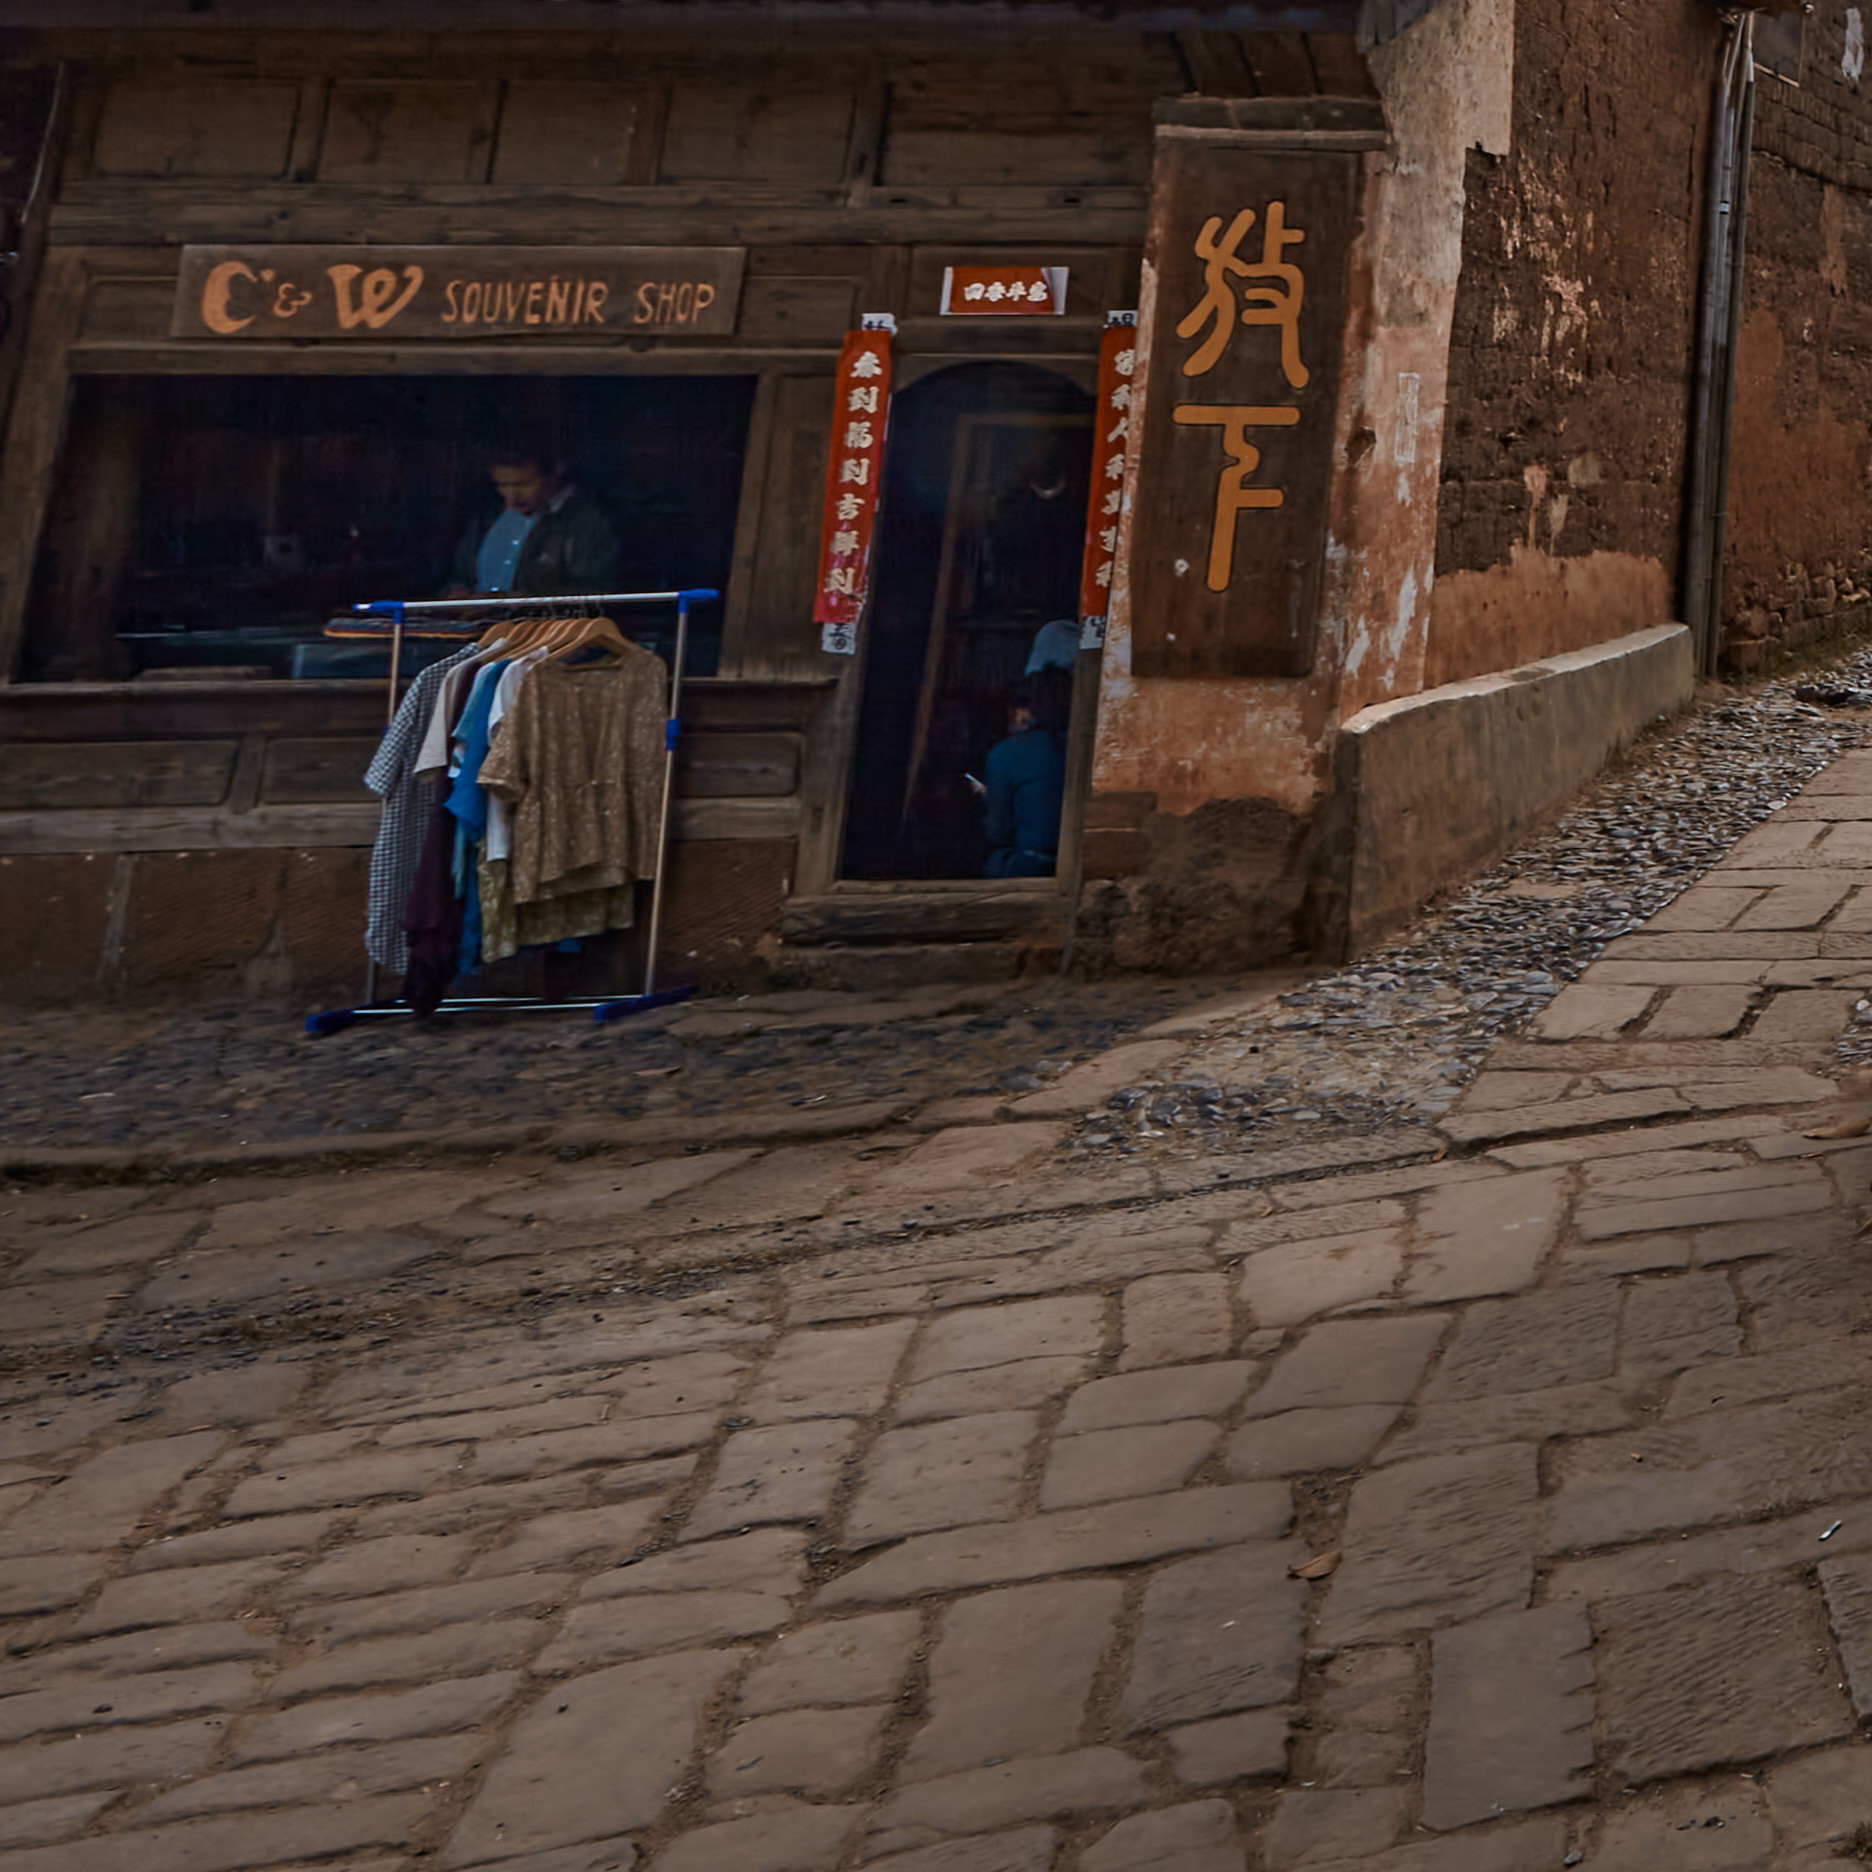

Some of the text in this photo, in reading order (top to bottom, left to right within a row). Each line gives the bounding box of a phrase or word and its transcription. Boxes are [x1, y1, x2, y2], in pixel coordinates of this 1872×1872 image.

[202, 260, 262, 335] C
[441, 277, 609, 325] SOUVENIR
[632, 280, 716, 325] SHOP
[823, 350, 883, 595] 春到福到吉祥到
